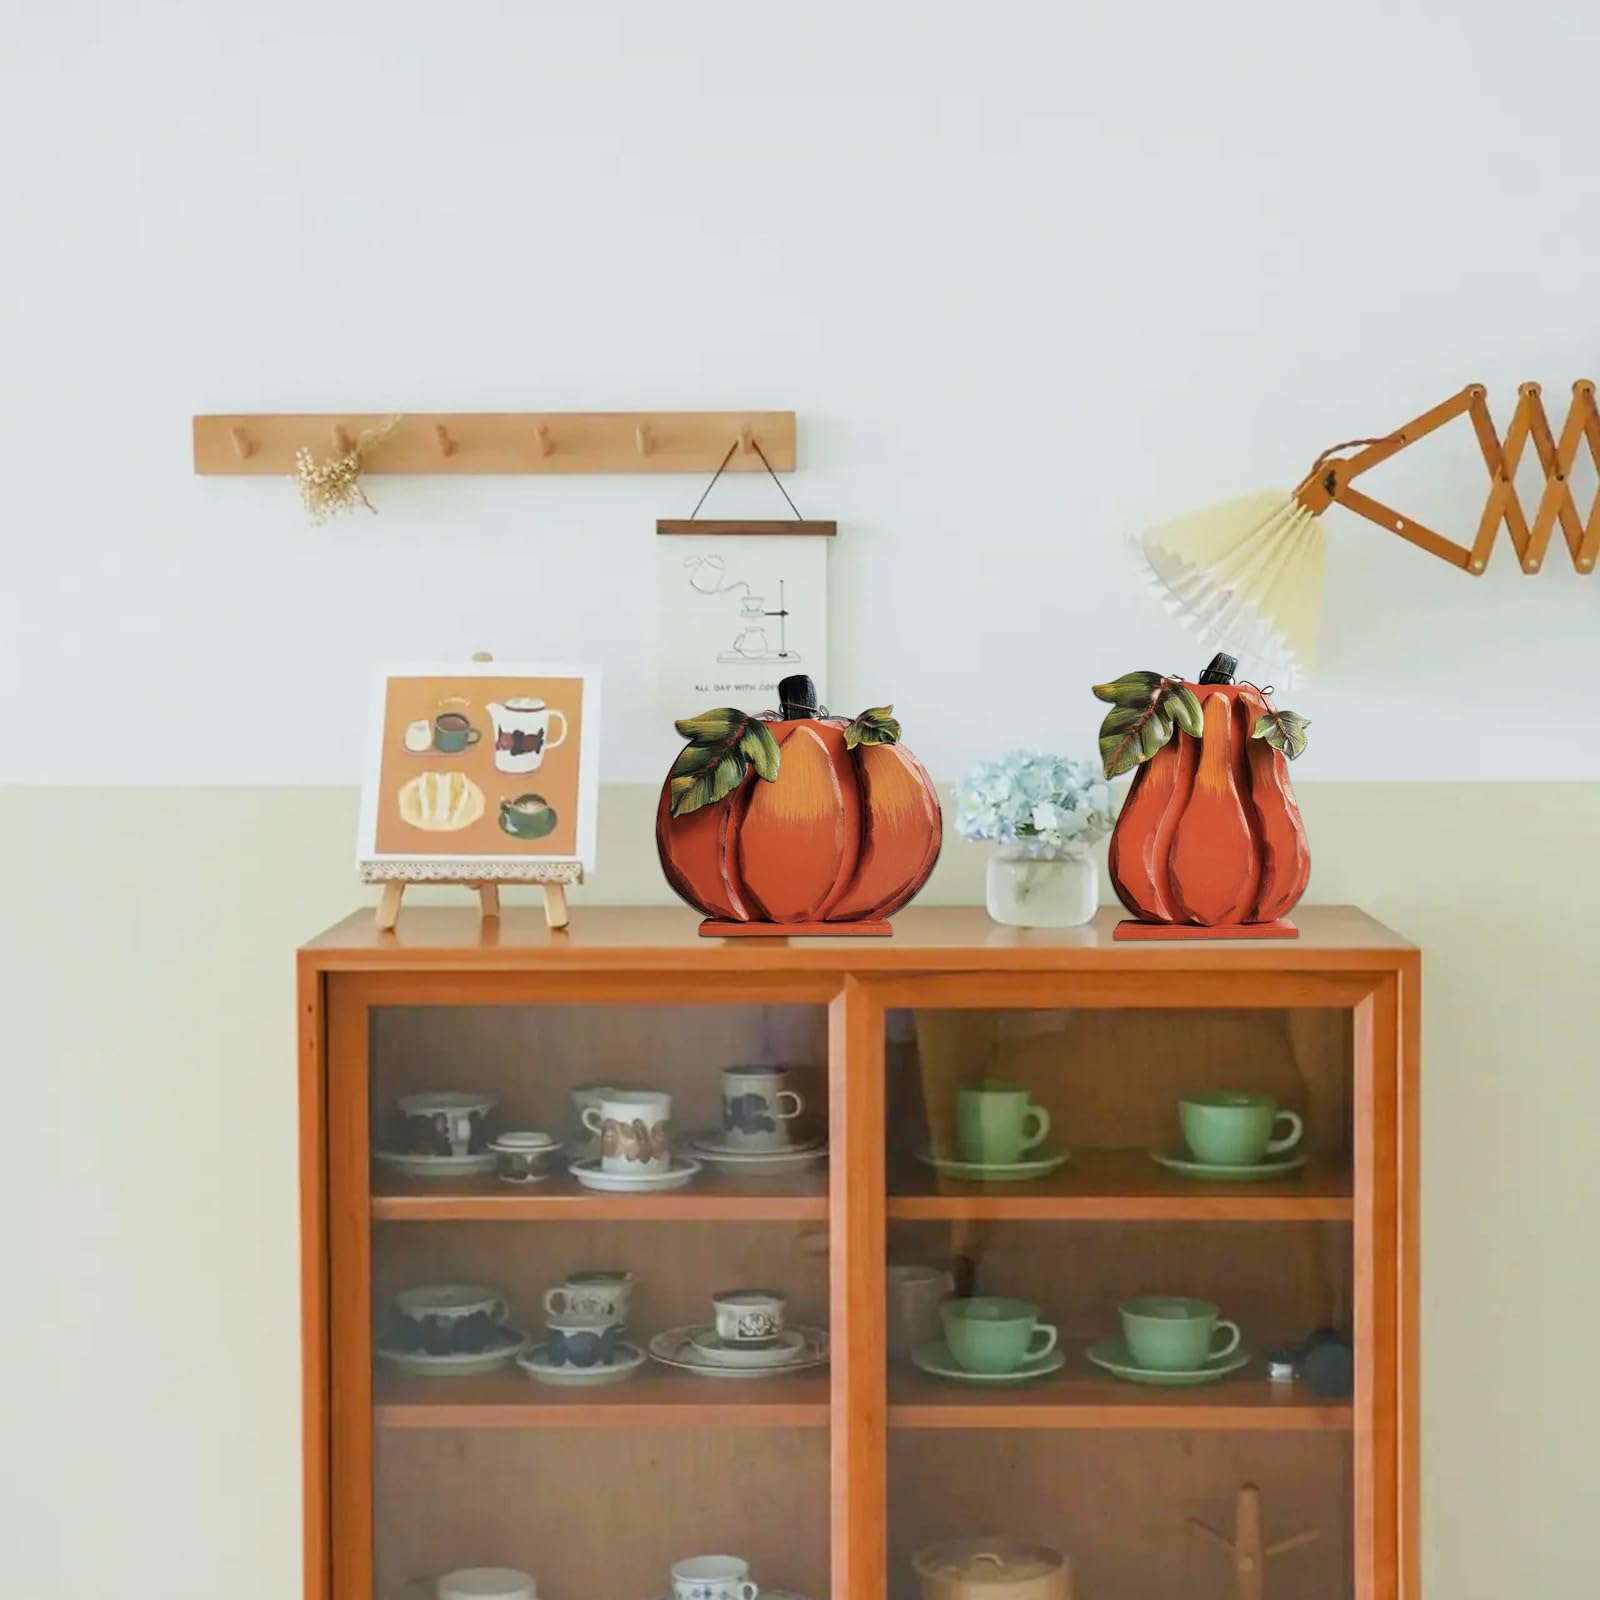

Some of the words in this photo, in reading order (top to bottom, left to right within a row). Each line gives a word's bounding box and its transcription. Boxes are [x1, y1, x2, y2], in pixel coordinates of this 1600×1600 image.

[695, 683, 709, 692] ALL
[713, 683, 730, 692] DAY
[734, 683, 756, 692] WITH
